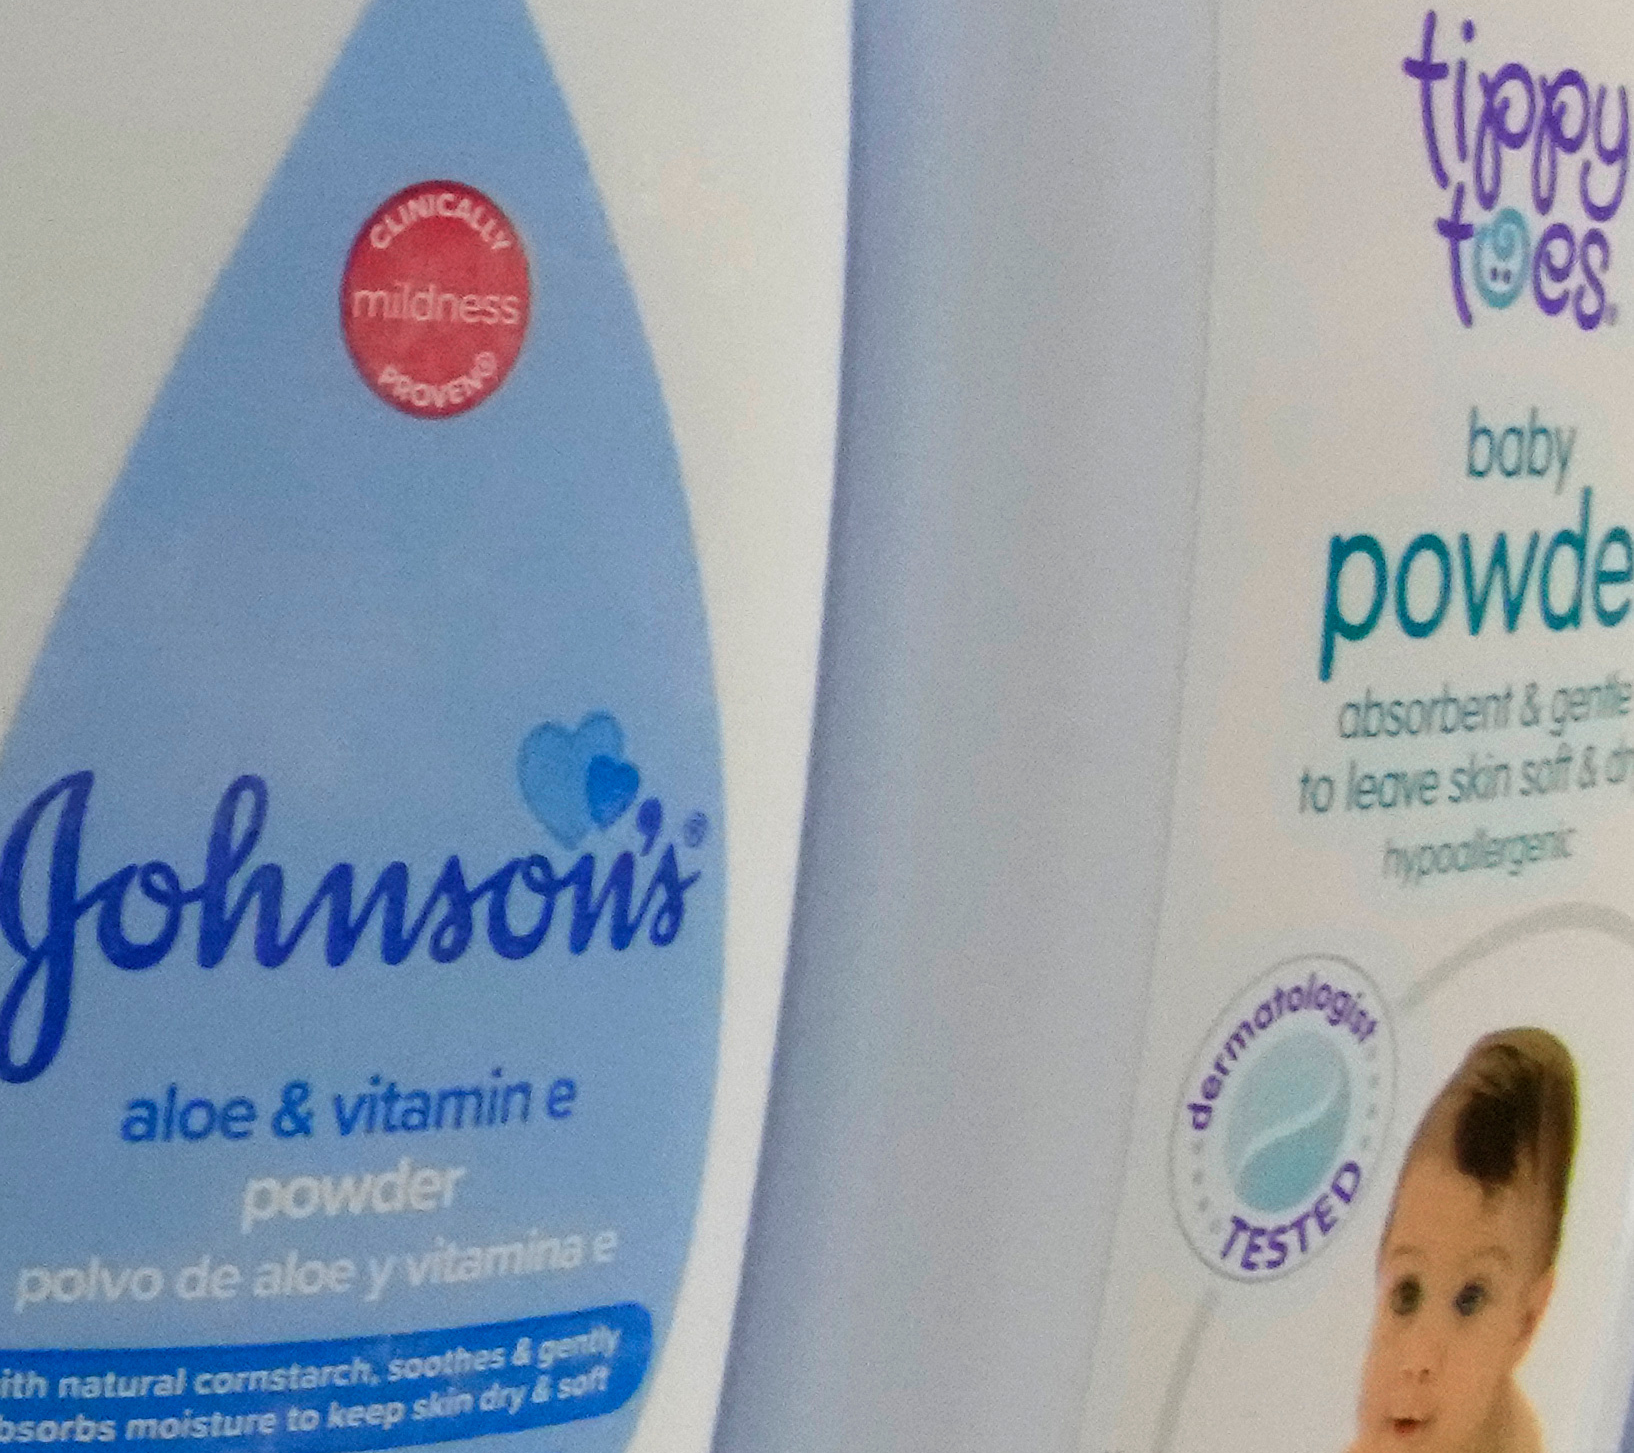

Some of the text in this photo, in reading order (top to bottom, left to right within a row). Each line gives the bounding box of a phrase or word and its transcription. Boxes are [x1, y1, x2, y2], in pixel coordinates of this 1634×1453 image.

[1402, 9, 1629, 222] tippy
[369, 193, 512, 250] CLINICALLY
[352, 279, 519, 325] mildness
[1466, 406, 1577, 495] baby
[1338, 684, 1513, 738] absorbent
[1520, 681, 1540, 726] &
[1298, 766, 1335, 813] to
[1346, 760, 1439, 812] leave
[1448, 752, 1510, 803] skin
[1187, 972, 1377, 1131] dermatologist
[121, 1068, 532, 1144] aloe vitamin
[241, 1157, 468, 1234] powder
[1220, 1160, 1361, 1271] TESTED
[13, 1228, 587, 1314] polvo de aloe vitamina
[58, 1368, 186, 1399] natural
[195, 1359, 380, 1397] cornstarch,
[387, 1343, 505, 1383] soothes
[536, 1325, 622, 1367] gently
[125, 1409, 276, 1443] moisture
[286, 1403, 320, 1435] to
[327, 1397, 406, 1435] keep
[412, 1389, 474, 1422] skin
[480, 1383, 526, 1417] dry
[556, 1367, 608, 1402] soft
